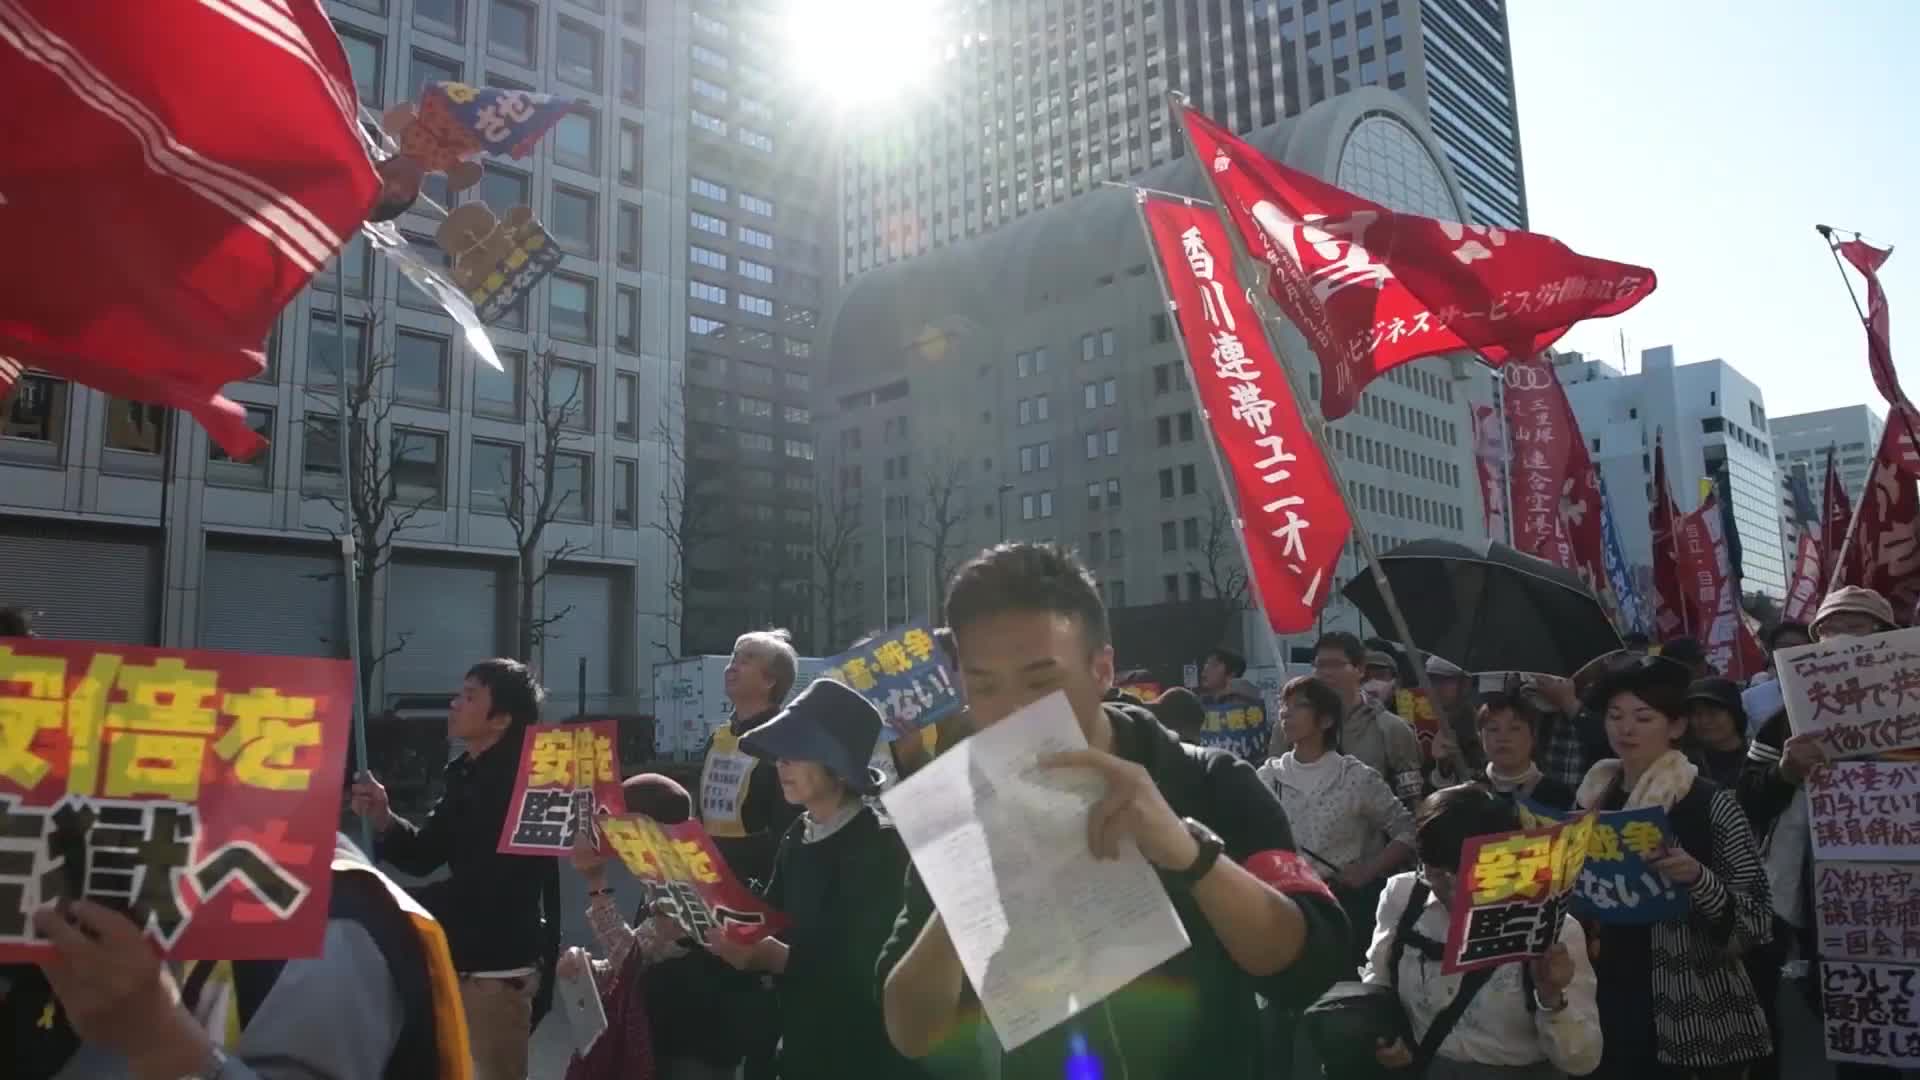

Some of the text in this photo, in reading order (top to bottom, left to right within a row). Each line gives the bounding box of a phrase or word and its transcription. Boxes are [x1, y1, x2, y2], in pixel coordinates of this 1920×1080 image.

[1179, 225, 1323, 607] 香川連帯ユニオン
[1812, 792, 1920, 819] 関与してい
